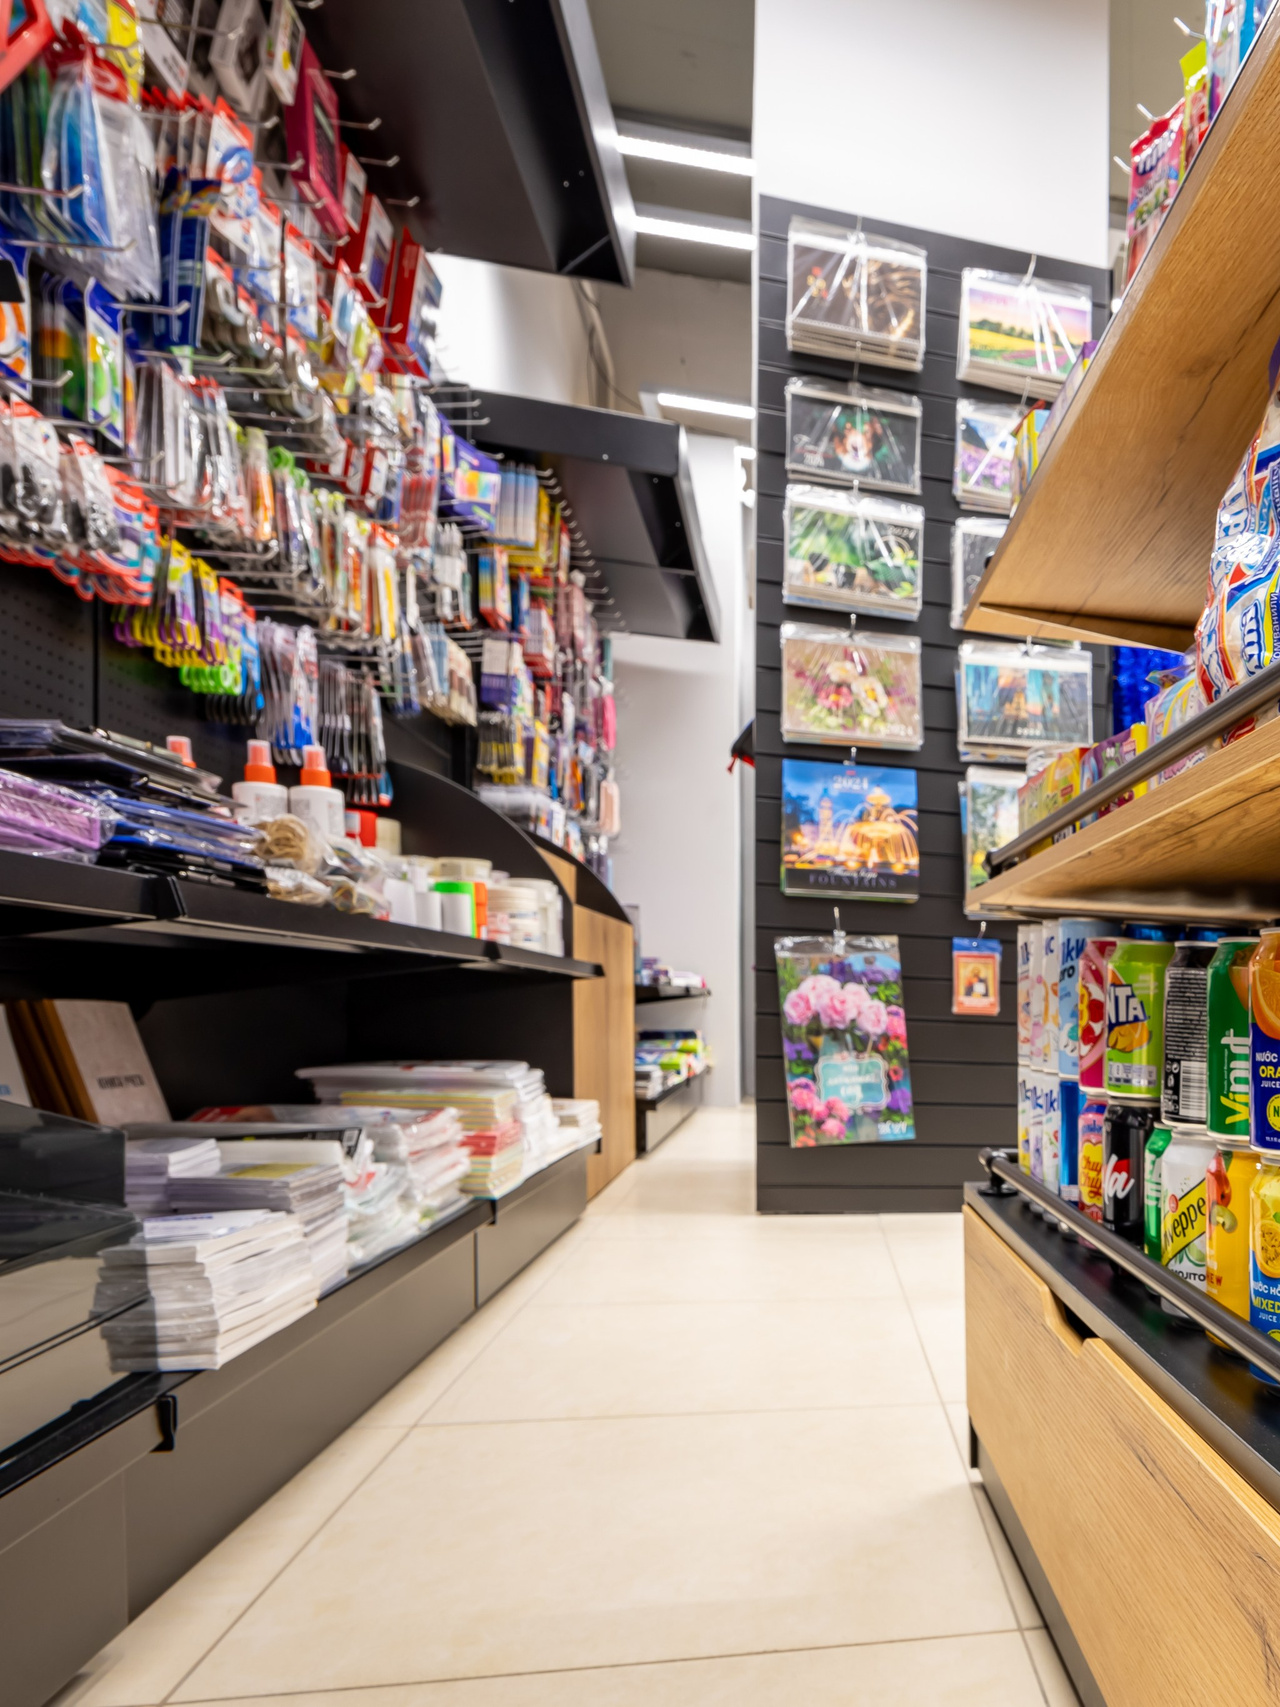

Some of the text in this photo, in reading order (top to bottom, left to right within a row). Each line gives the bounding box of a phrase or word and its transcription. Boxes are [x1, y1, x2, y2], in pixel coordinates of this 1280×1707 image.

[808, 873, 899, 889] FOUNTAINS
[1261, 1080, 1280, 1089] JUICE
[1259, 1312, 1278, 1323] JUICE
